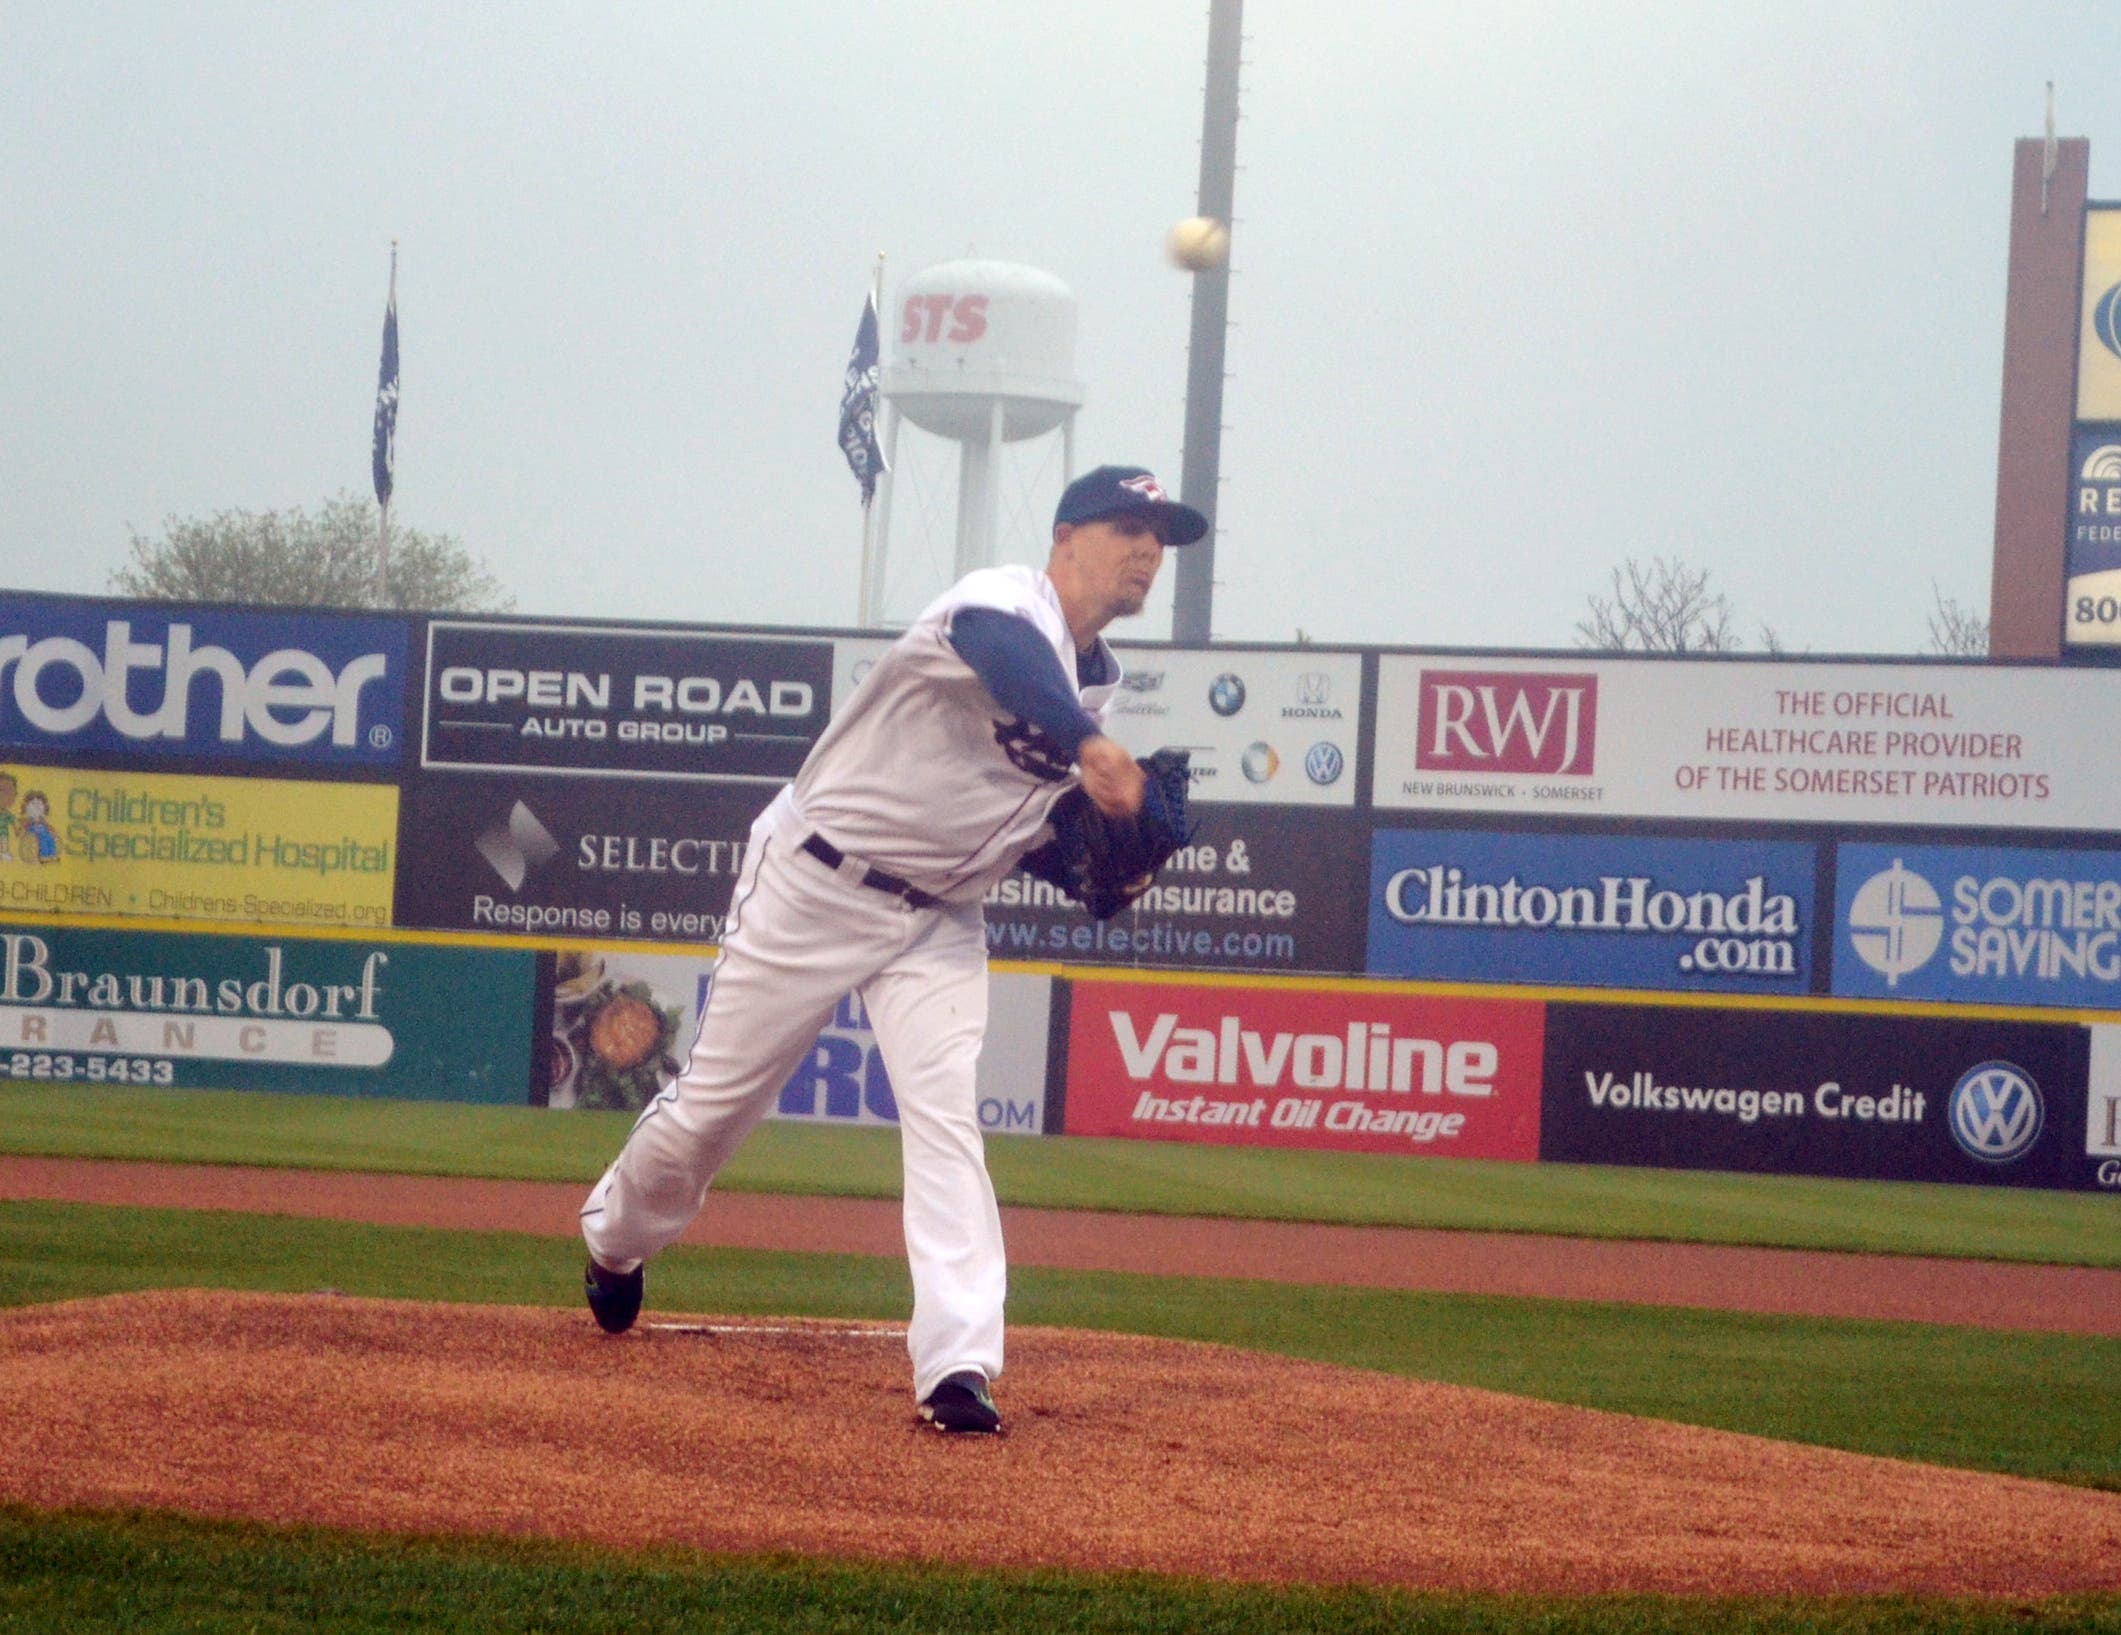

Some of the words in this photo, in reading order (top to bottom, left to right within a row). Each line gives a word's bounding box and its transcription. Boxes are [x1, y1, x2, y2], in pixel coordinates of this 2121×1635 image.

[901, 294, 990, 343] STS
[2075, 596, 2121, 624] 80
[439, 667, 610, 707] OPEN
[633, 675, 813, 716] ROAD
[1775, 690, 1825, 716] THE
[1833, 692, 1953, 718] OFFICIAL
[520, 718, 606, 738] AUTO
[617, 721, 728, 743] GROUP
[1281, 707, 1342, 719] HONDA
[1428, 684, 1585, 775] RWJ
[1706, 728, 1876, 755] HEALTHCARE
[1886, 731, 2023, 760] PROVIDER
[1402, 781, 1433, 795] NEW
[1436, 782, 1515, 797] BRUNSWICK
[1532, 785, 1603, 800] SOMERSET
[1676, 765, 1709, 790] OF
[1717, 766, 1766, 792] THE
[1774, 768, 1917, 795] SOMERSET
[1923, 772, 2050, 799] PATRIOTS
[67, 787, 226, 828] Children's
[66, 822, 248, 866] Specialized
[255, 833, 388, 876] Hospital
[578, 837, 748, 873] SELECTI
[1225, 838, 1249, 873] &
[473, 895, 611, 930] Response
[620, 904, 642, 930] is
[1385, 865, 1798, 935] ClintonHonda
[1953, 875, 2121, 929] SOMER
[1680, 937, 1795, 974] .com
[1950, 925, 2121, 982] SAVING
[1, 934, 389, 1019] Braunsdorf
[1109, 1010, 1498, 1096] Valvoline
[1585, 1071, 1804, 1121] Volkswagen
[1815, 1082, 1926, 1121] Credit
[1131, 1091, 1265, 1127] Instant
[1271, 1098, 1316, 1129] Oil
[1325, 1100, 1466, 1143] Change
